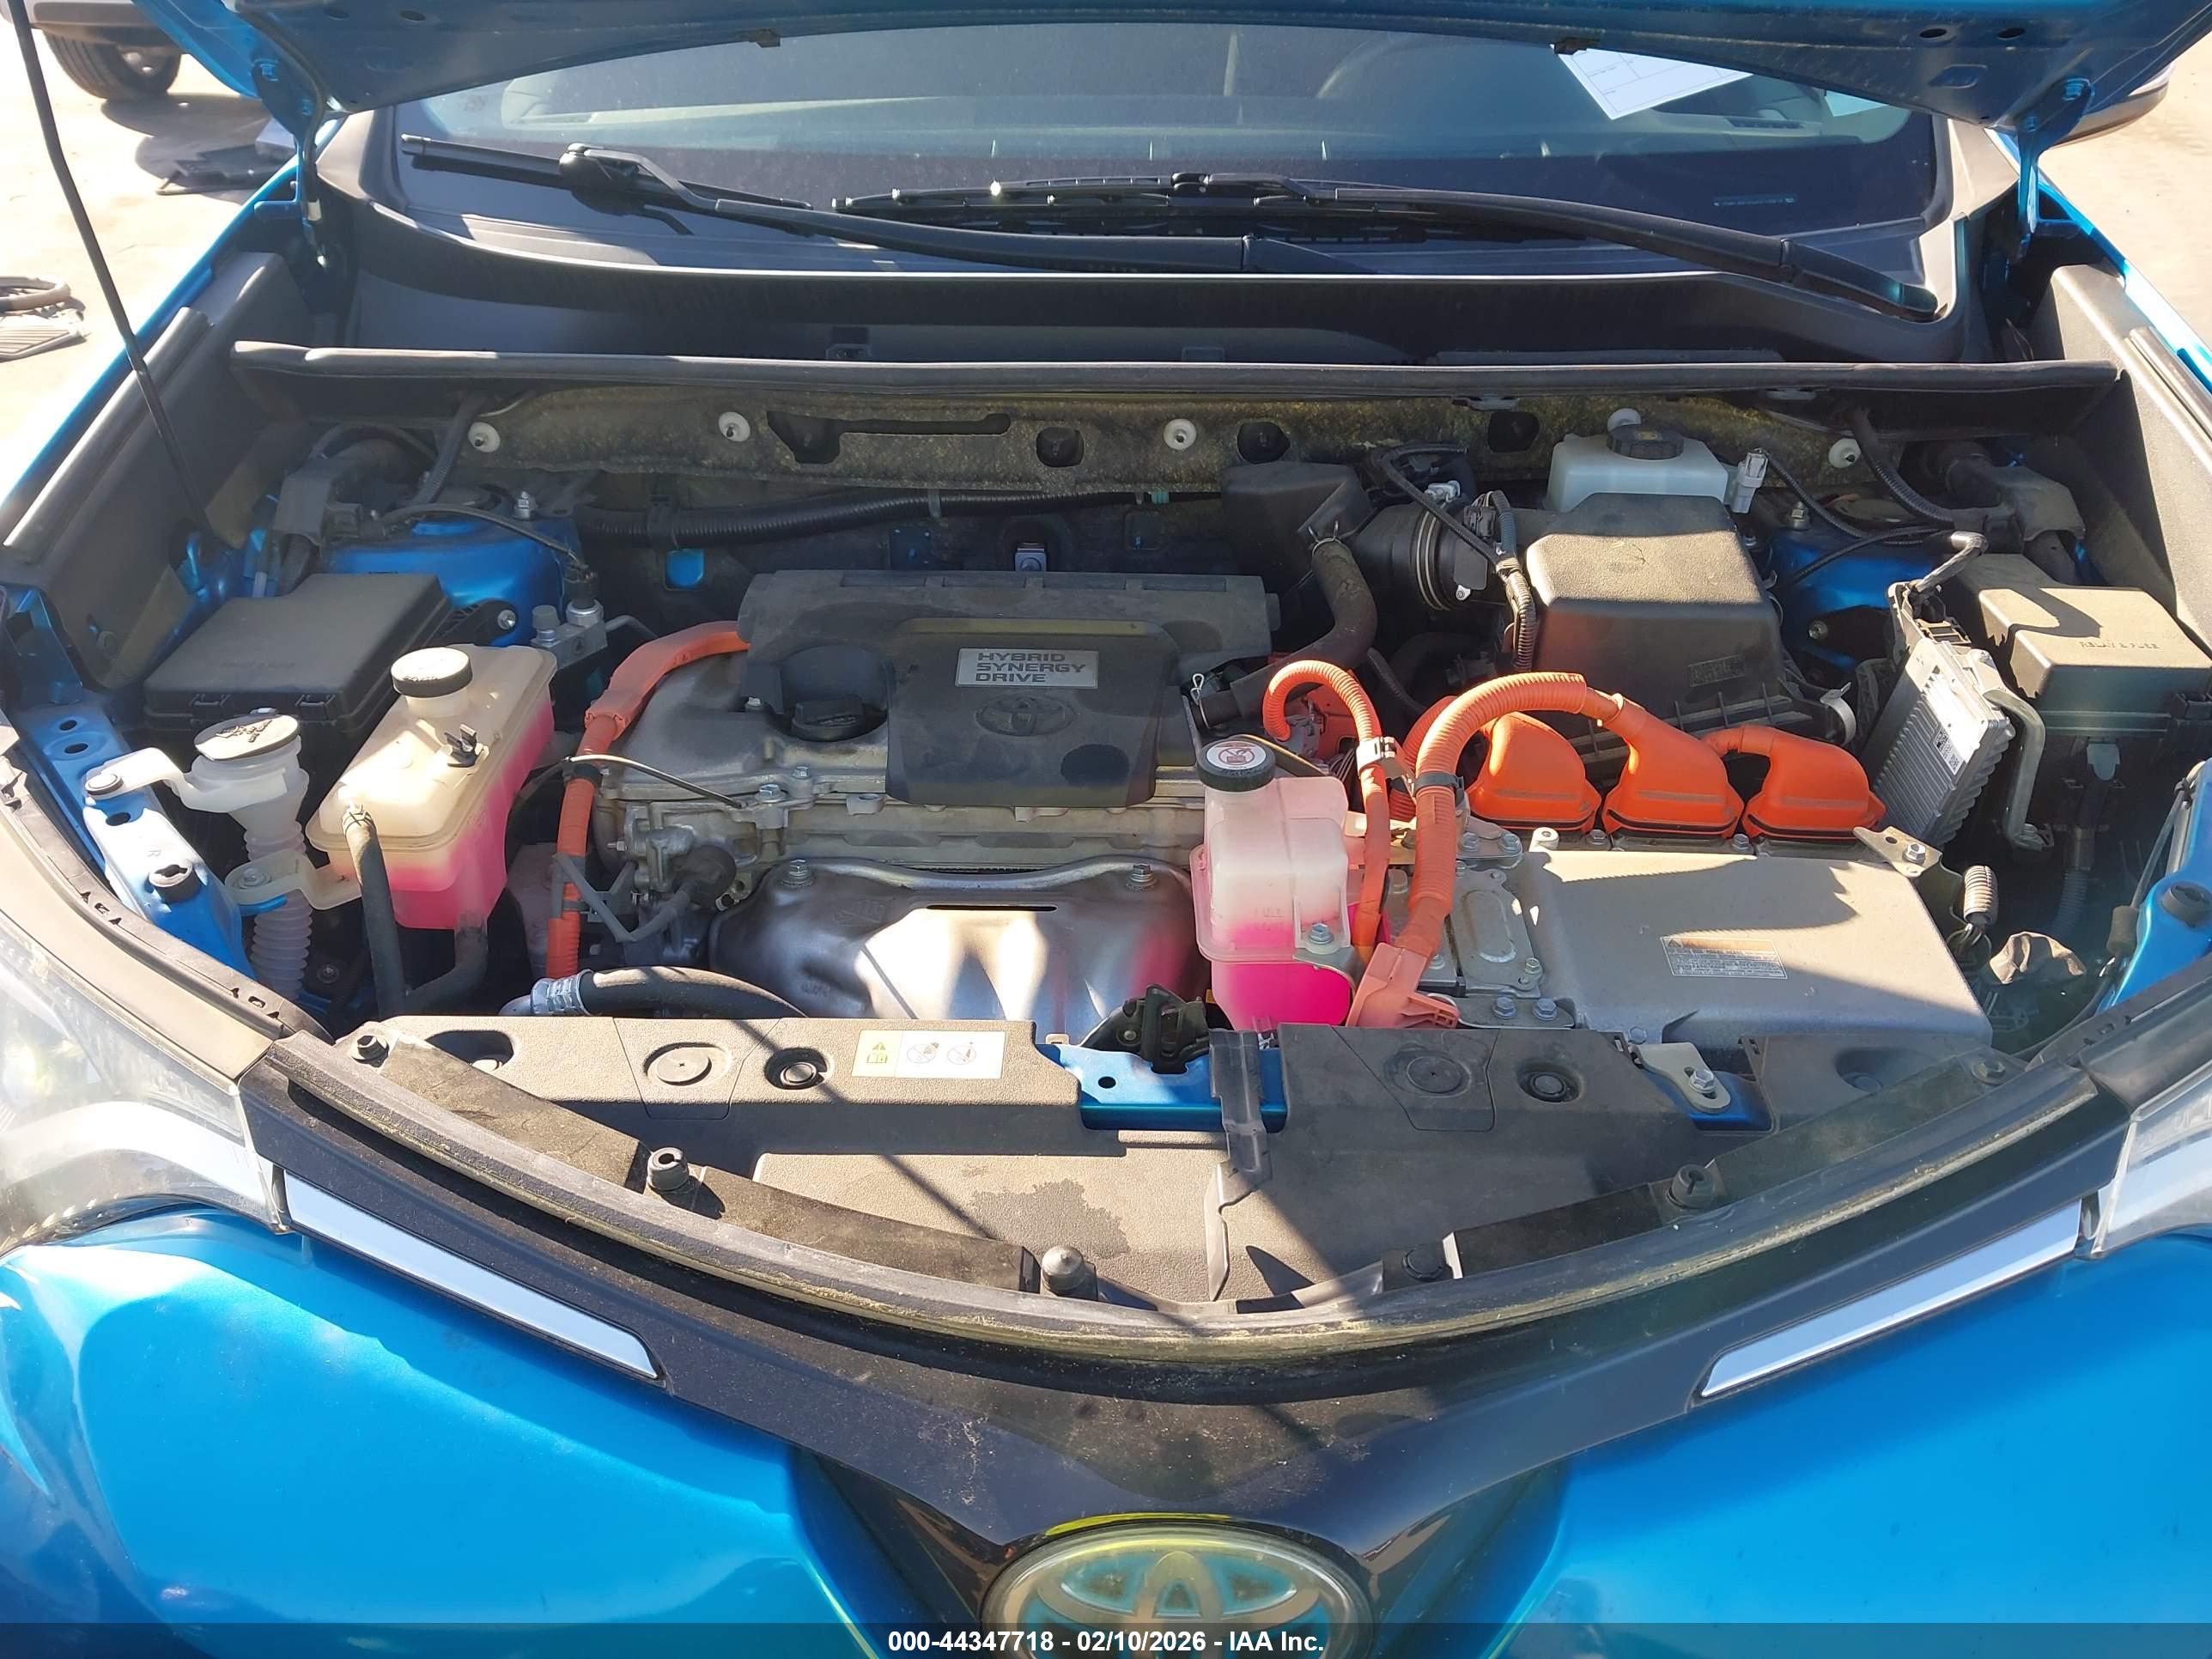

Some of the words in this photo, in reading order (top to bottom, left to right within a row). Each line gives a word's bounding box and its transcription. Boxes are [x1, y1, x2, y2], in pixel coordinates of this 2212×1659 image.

[978, 652, 1066, 662] HYBRID
[976, 662, 1086, 673] SYNERGY
[975, 672, 1047, 683] DRIVE
